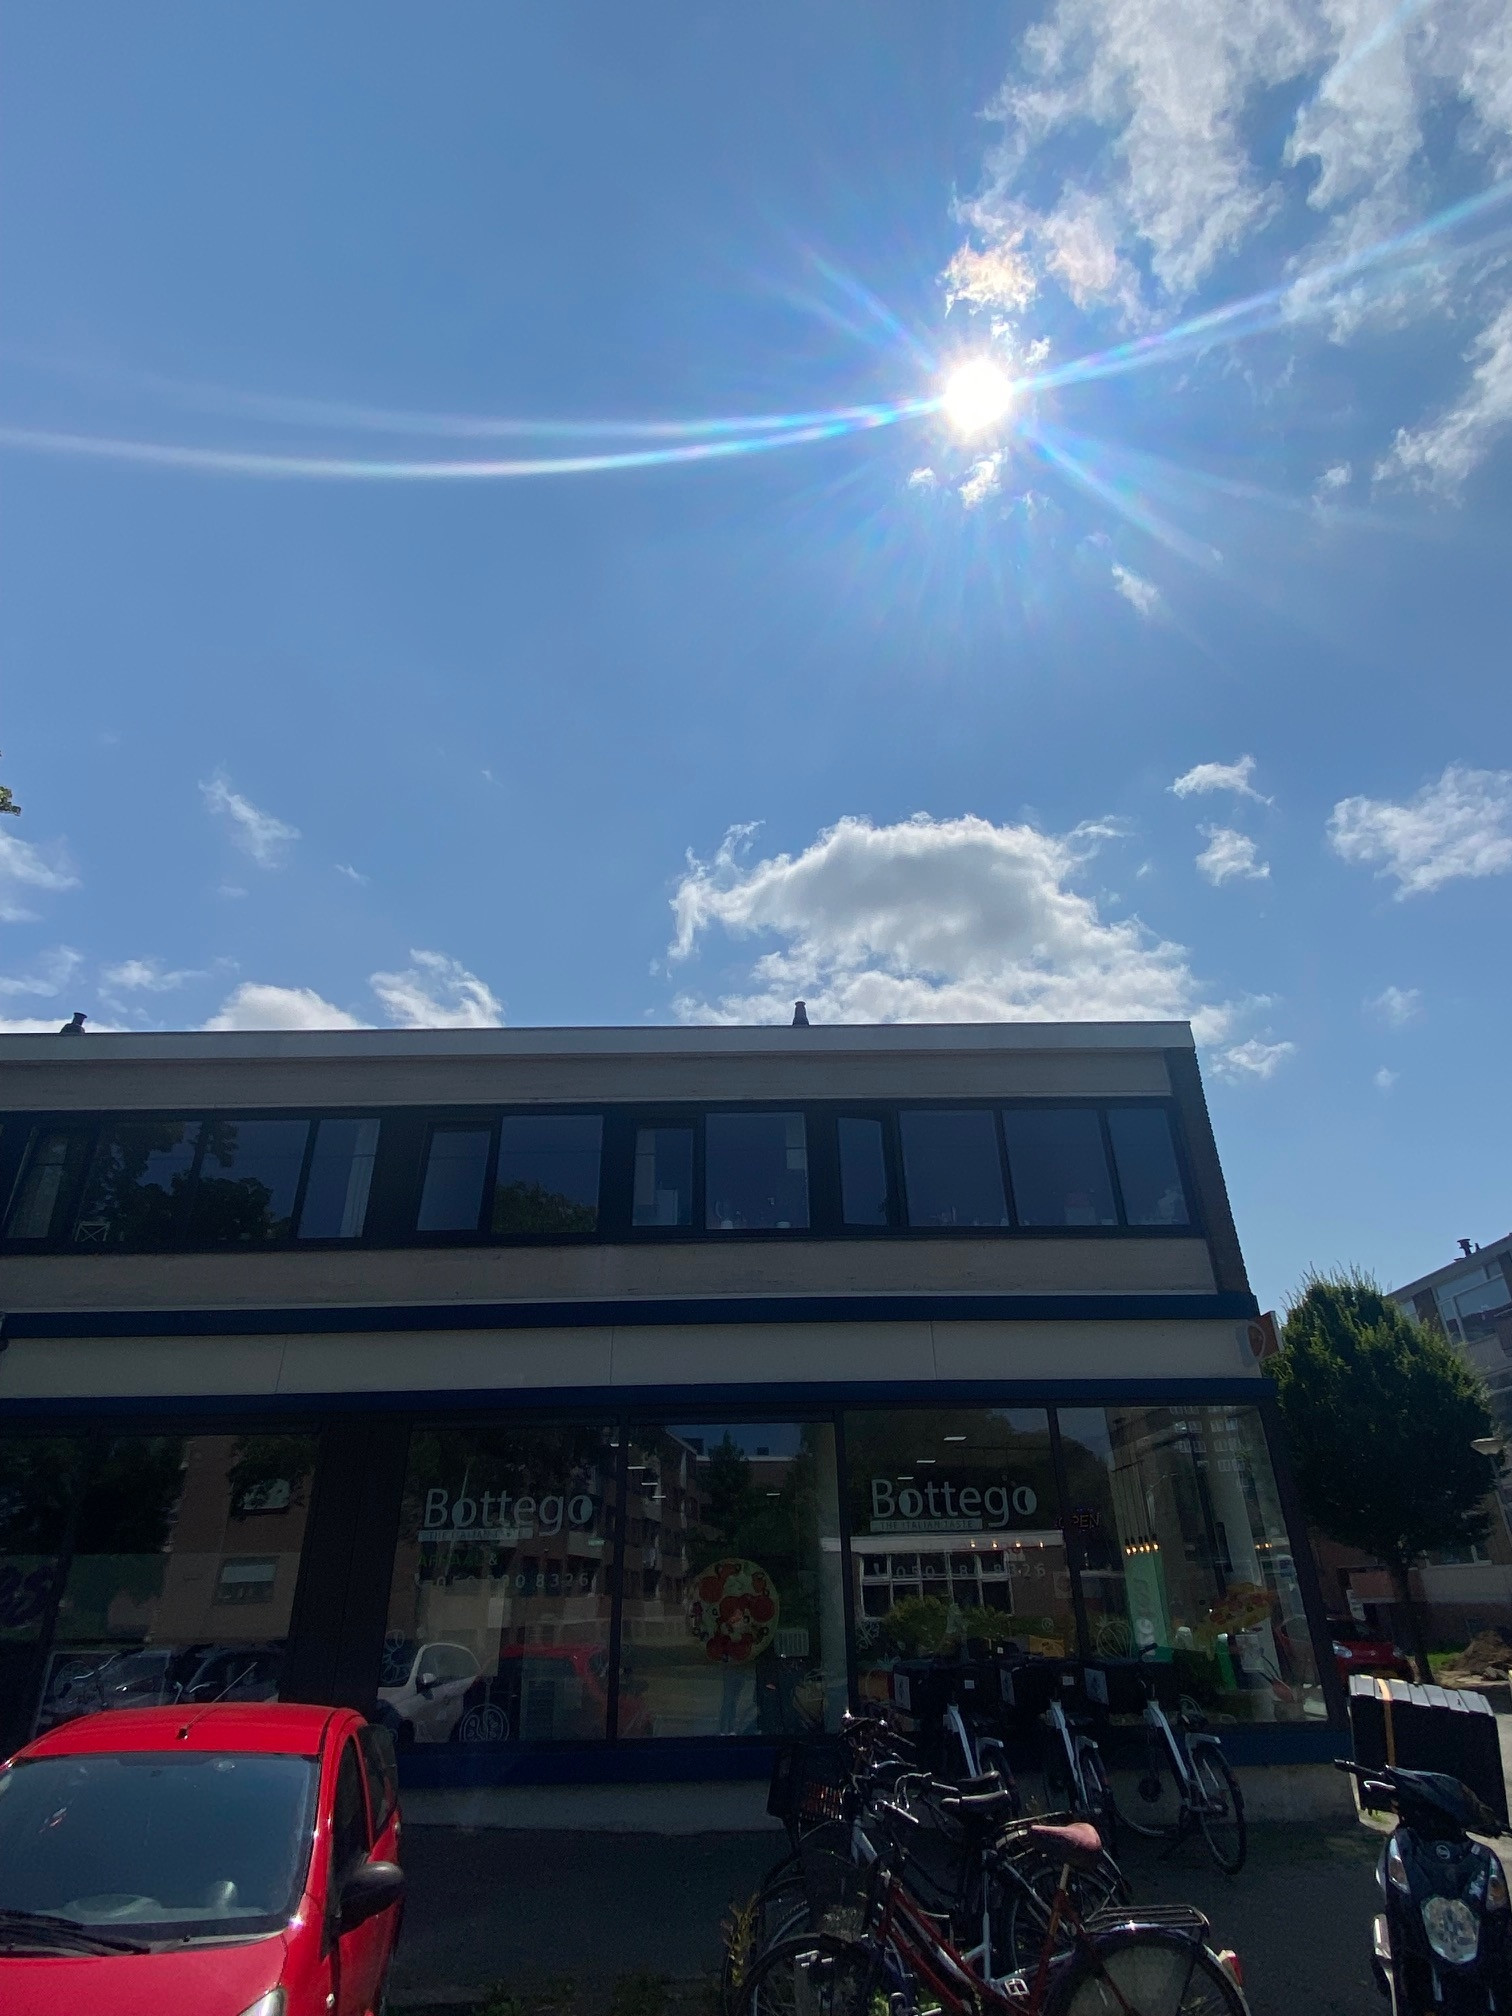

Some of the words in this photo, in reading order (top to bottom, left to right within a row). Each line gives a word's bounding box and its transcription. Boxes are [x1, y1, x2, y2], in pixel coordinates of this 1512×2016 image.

[871, 1478, 1038, 1528] Bottego
[423, 1488, 593, 1536] Bottego
[880, 1521, 897, 1530] THE
[901, 1520, 940, 1530] ITALIAN
[943, 1518, 974, 1529] TASTE
[488, 1552, 498, 1566] &
[534, 1572, 589, 1589] 8326
